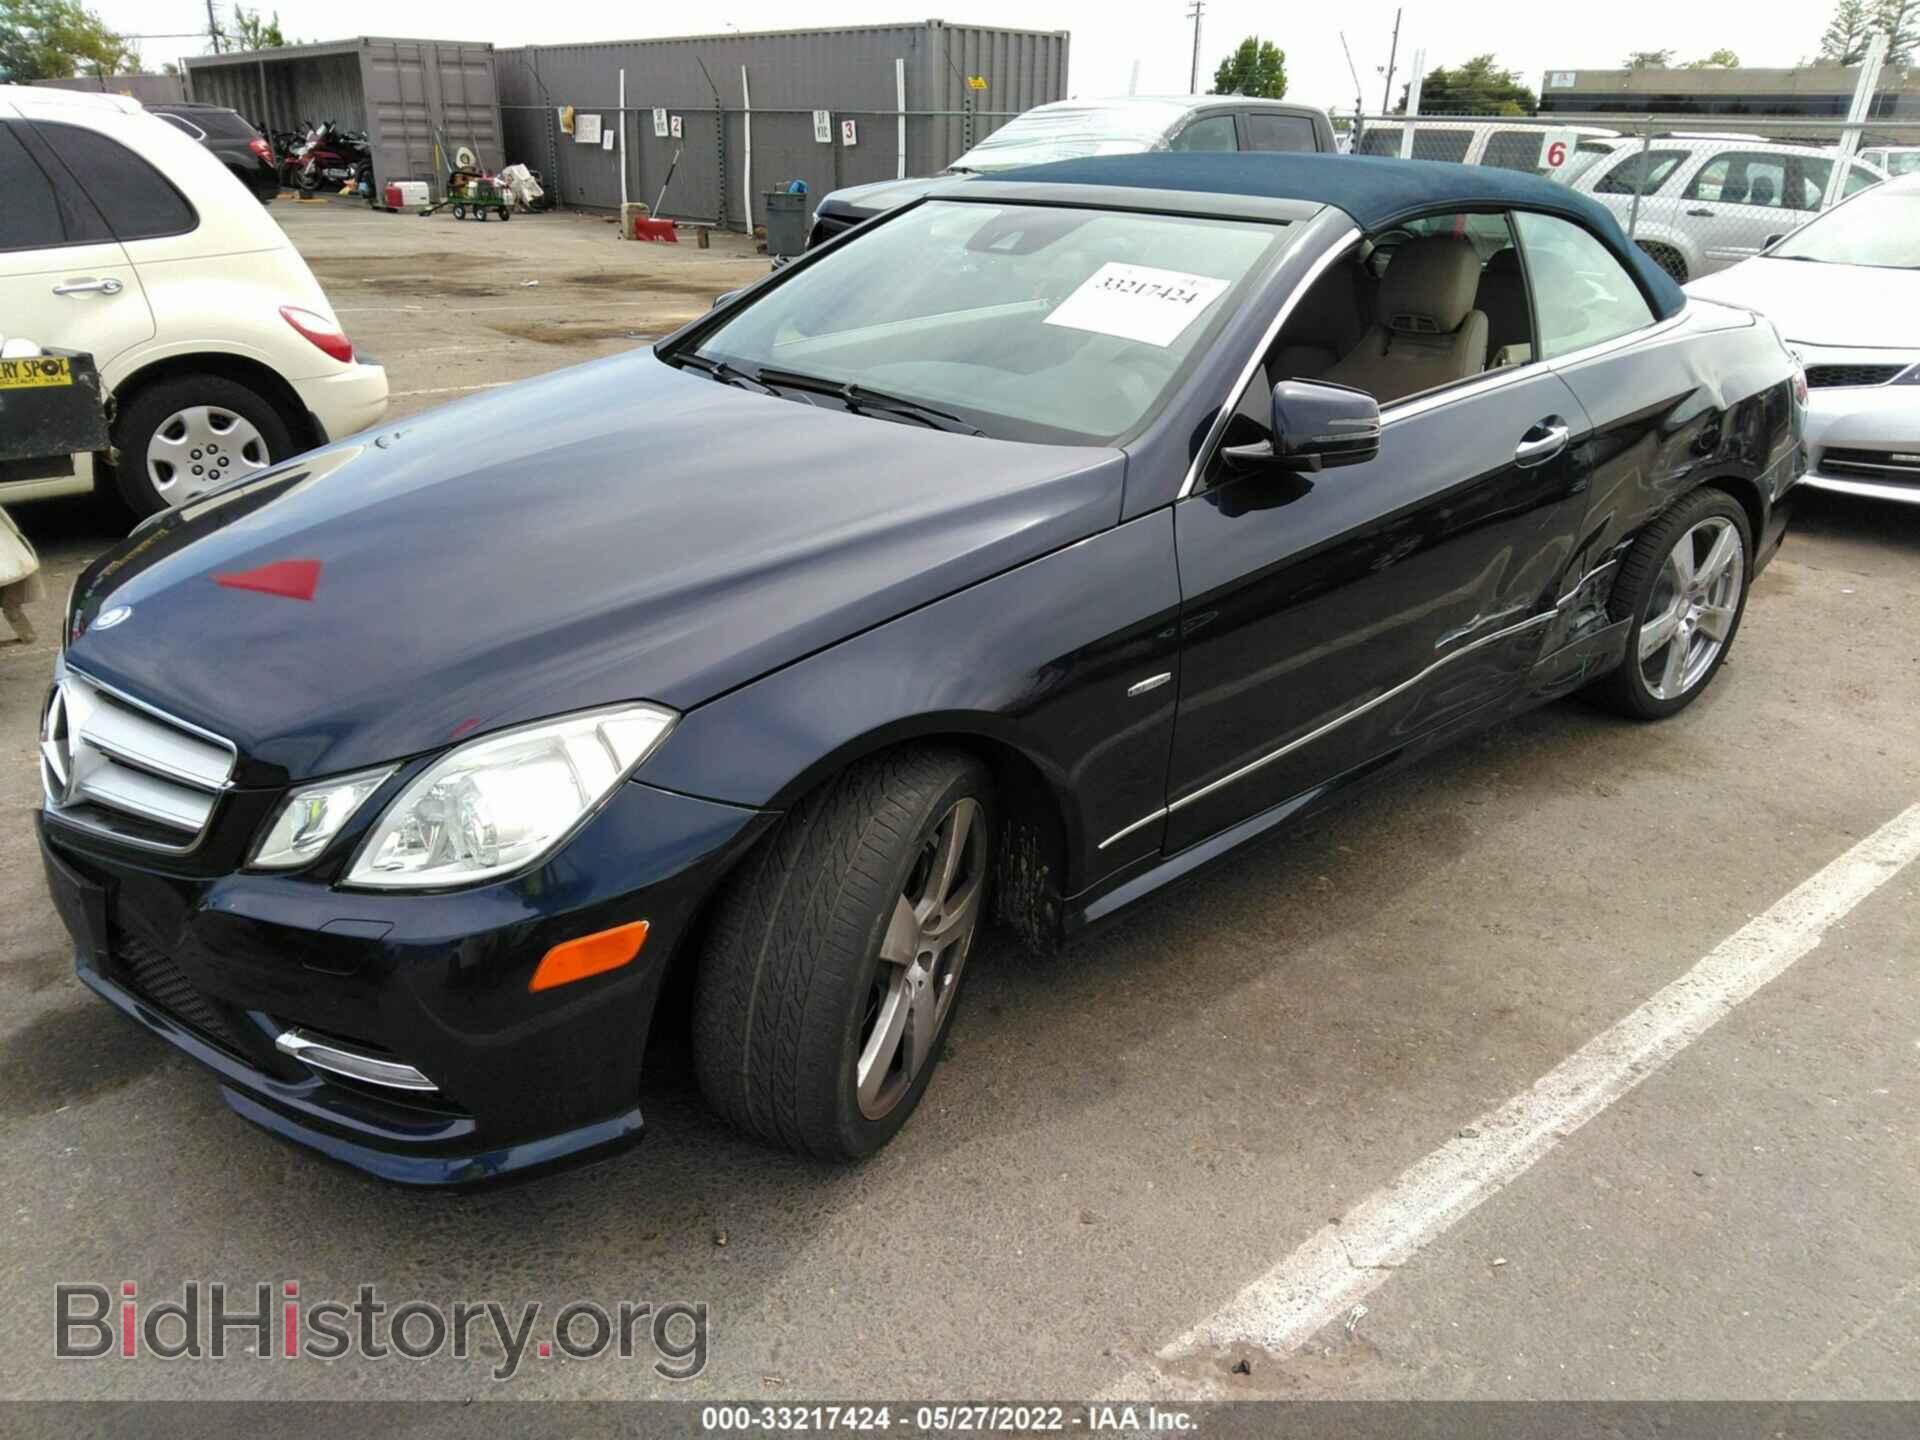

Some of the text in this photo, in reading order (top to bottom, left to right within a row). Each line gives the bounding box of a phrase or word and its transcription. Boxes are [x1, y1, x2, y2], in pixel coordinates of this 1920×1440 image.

[672, 118, 680, 131] 2
[844, 121, 853, 139] 3
[1548, 142, 1567, 167] 6
